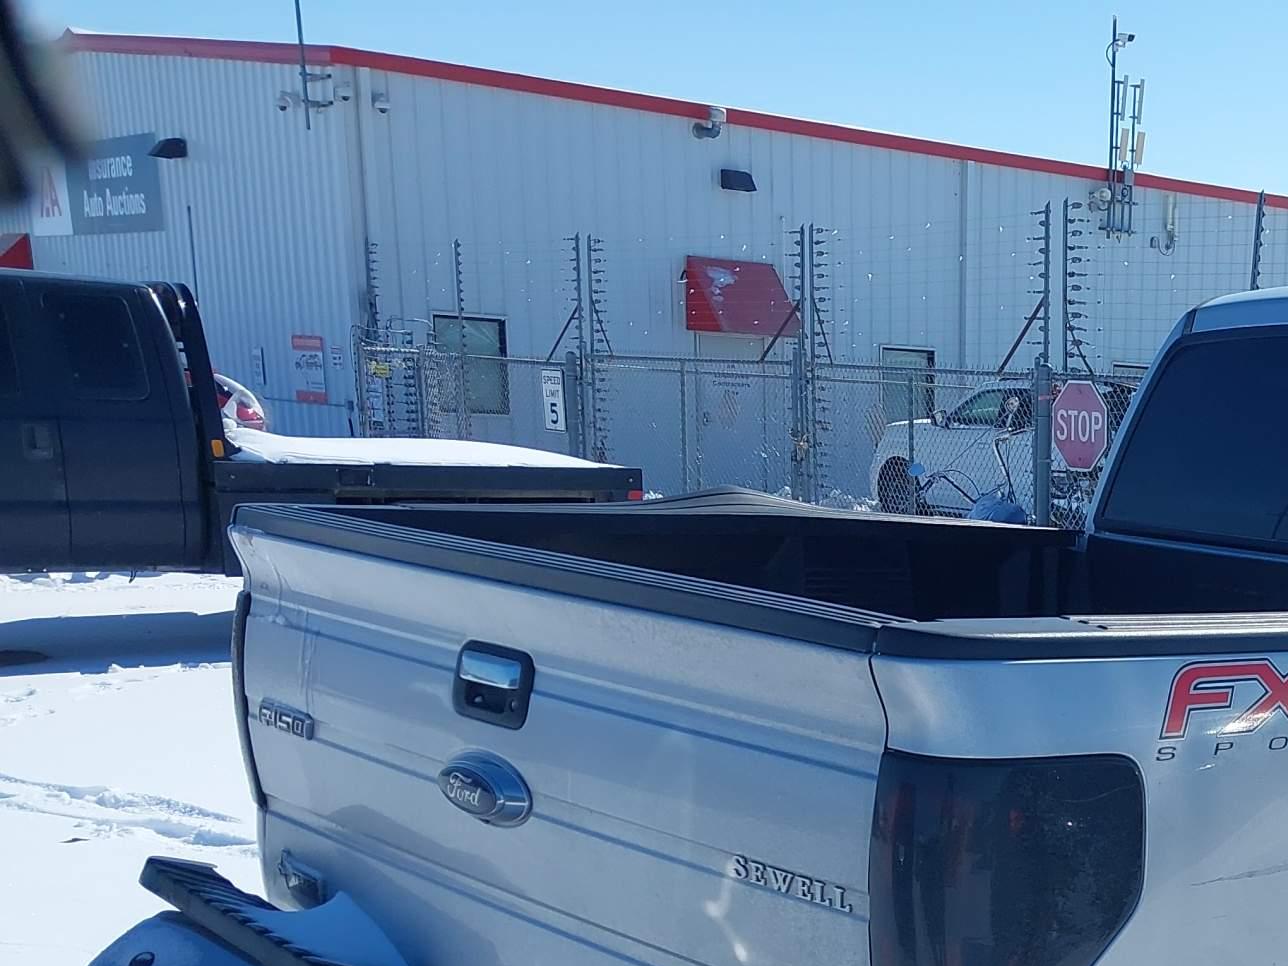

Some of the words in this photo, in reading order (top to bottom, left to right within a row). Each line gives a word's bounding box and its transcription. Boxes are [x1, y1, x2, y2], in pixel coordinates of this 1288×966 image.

[83, 189, 104, 218] Auto
[106, 186, 146, 217] Auctions
[543, 375, 561, 385] SPEED
[545, 388, 560, 397] LIMIT
[550, 402, 559, 425] 5
[1056, 409, 1103, 443] STOP
[447, 772, 481, 807] Ford
[730, 854, 853, 913] SEWELL
